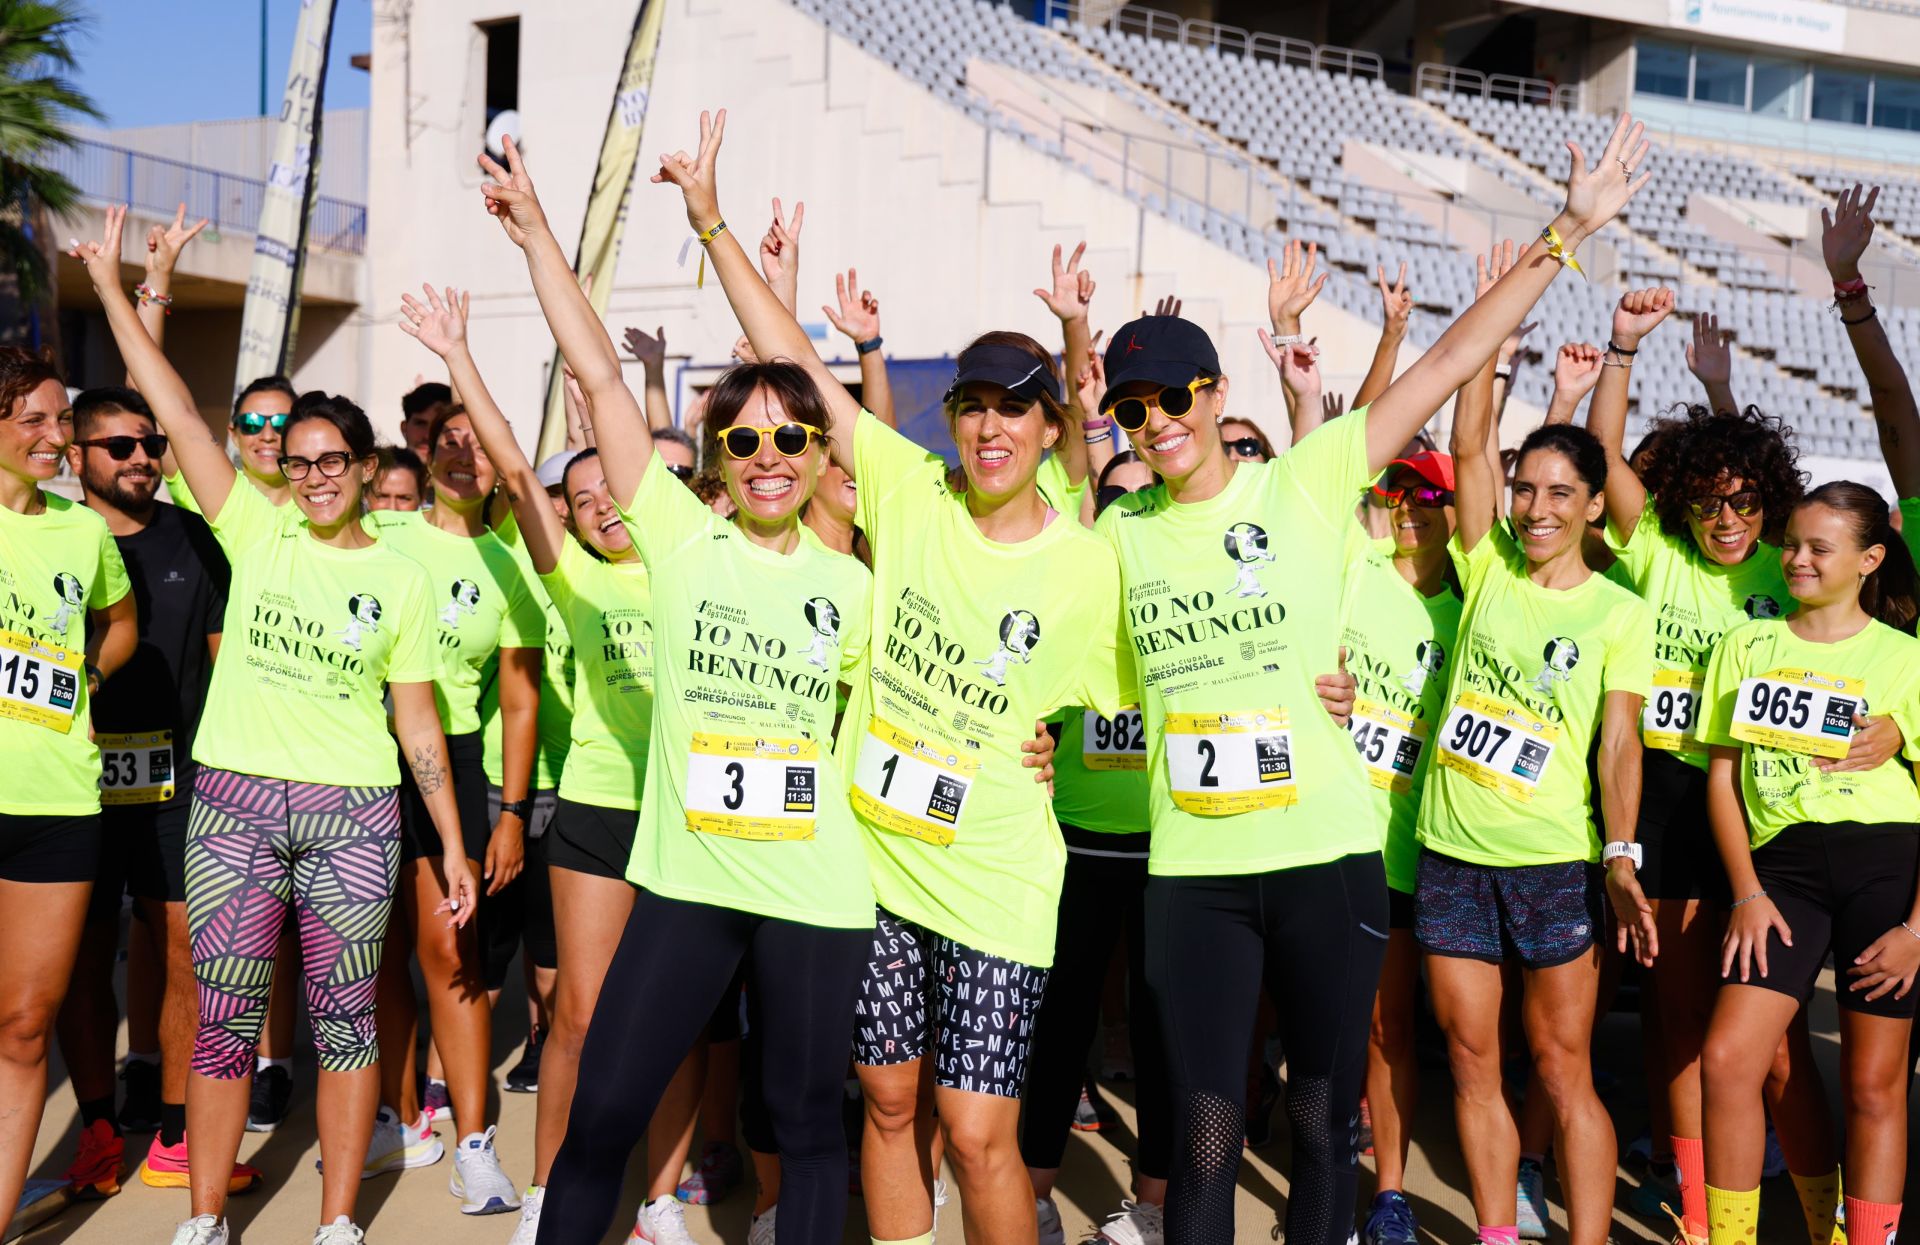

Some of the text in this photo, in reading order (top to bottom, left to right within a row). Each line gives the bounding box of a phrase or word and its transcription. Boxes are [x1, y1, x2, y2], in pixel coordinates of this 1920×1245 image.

[4, 592, 36, 620] NO
[1129, 590, 1214, 628] YO NO
[253, 605, 324, 639] YO NO
[601, 620, 653, 639] YO N
[1133, 602, 1286, 657] RENUNCIO
[1656, 618, 1682, 640] YO
[693, 619, 786, 659] YO NO
[893, 606, 965, 665] YO NO
[248, 628, 364, 676] RENUNCIO
[1179, 654, 1208, 666] CIUDAD
[0, 653, 40, 700] 15
[688, 649, 830, 702] RENUNCIO
[884, 633, 1009, 715] RENUNCIO
[1360, 654, 1390, 679] NO
[1489, 655, 1521, 682] NO
[53, 688, 73, 700] 10:00
[60, 677, 67, 686] 4
[871, 667, 938, 716] CORRESPONSABLE
[684, 689, 776, 710] CORRESPONSABLE
[732, 691, 762, 700] CIUDAD
[1749, 682, 1813, 729] 965
[1825, 717, 1849, 728] 10:00
[1836, 705, 1844, 714] 4
[1095, 713, 1146, 750] 982
[1348, 717, 1389, 763] 45
[1451, 714, 1512, 763] 907
[1198, 739, 1219, 787] 2
[1265, 746, 1279, 756] 13
[1529, 749, 1536, 757] 4
[880, 753, 900, 798] 1
[1260, 761, 1287, 772] 11:30
[1517, 758, 1539, 772] 10:00
[1752, 756, 1808, 778] RENU
[723, 762, 745, 810] 3
[794, 775, 806, 785] 13
[942, 786, 955, 797] 13
[787, 792, 812, 801] 11:30
[932, 799, 956, 814] 11:30
